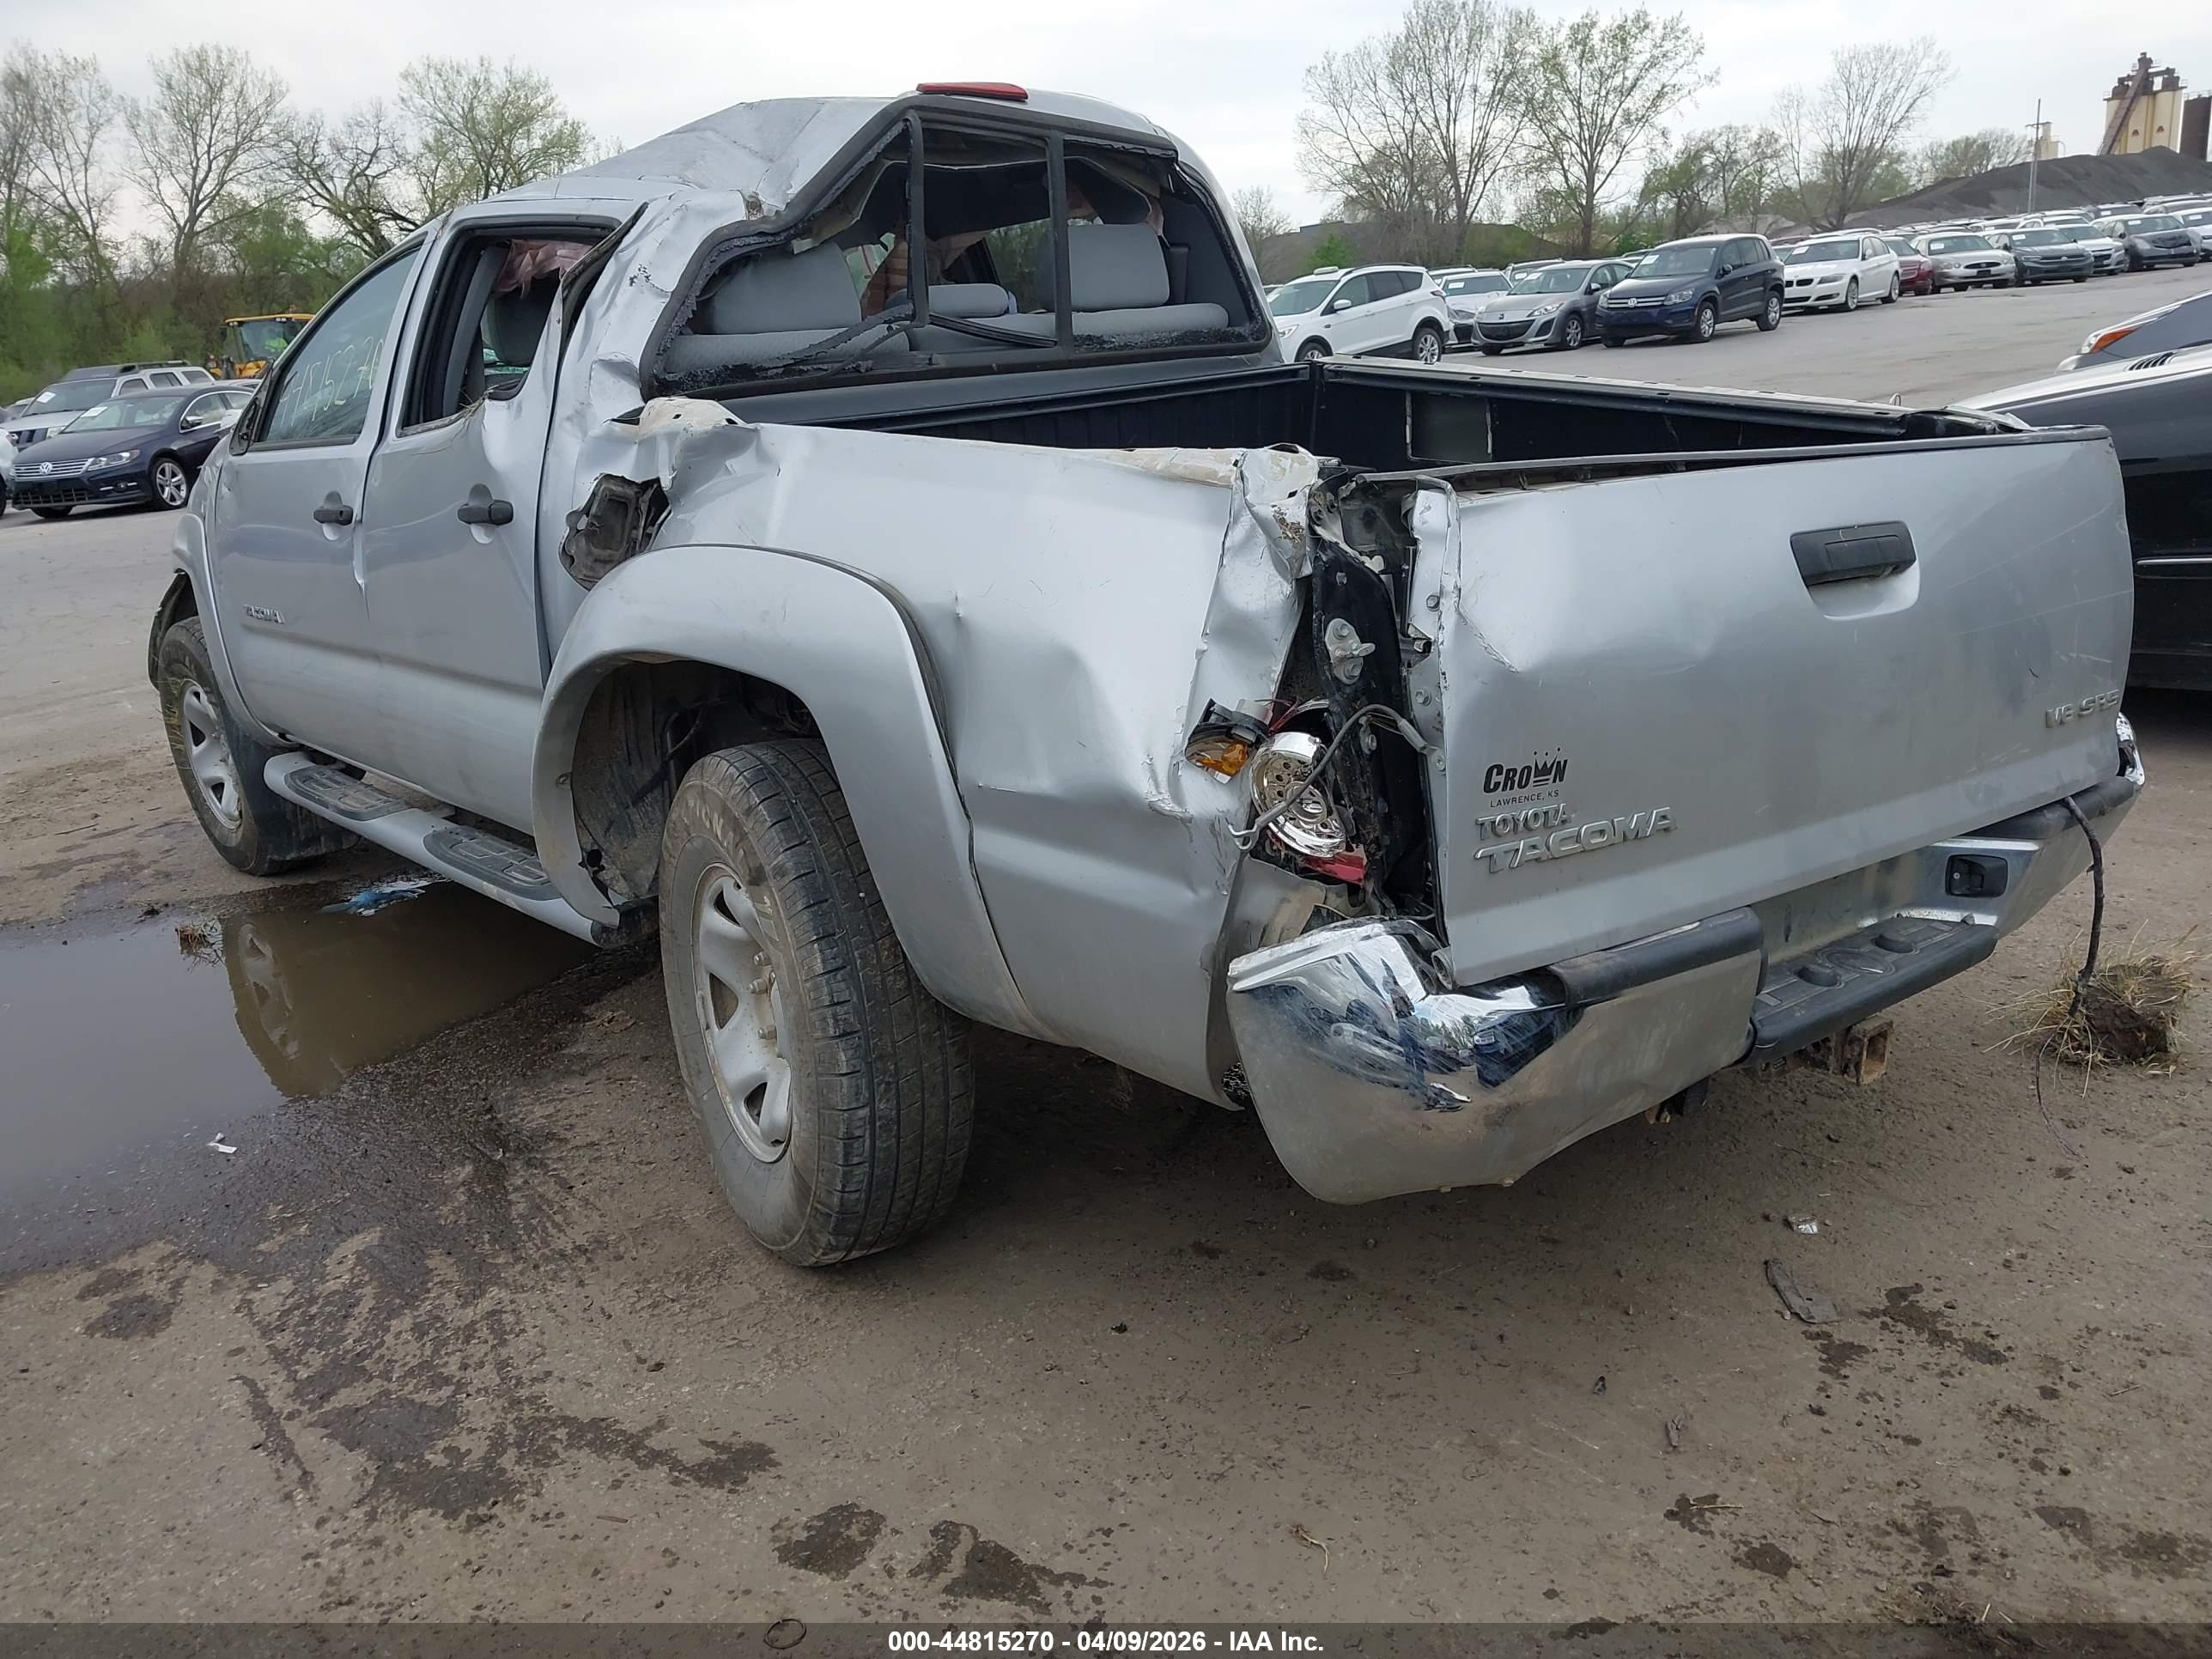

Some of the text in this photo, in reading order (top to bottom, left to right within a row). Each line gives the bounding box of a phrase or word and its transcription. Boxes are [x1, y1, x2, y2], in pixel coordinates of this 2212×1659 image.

[1490, 789, 1559, 808] LAWRENCE, KS
[1474, 806, 1678, 874] TACOMA
[1475, 803, 1573, 841] TOYOTA
